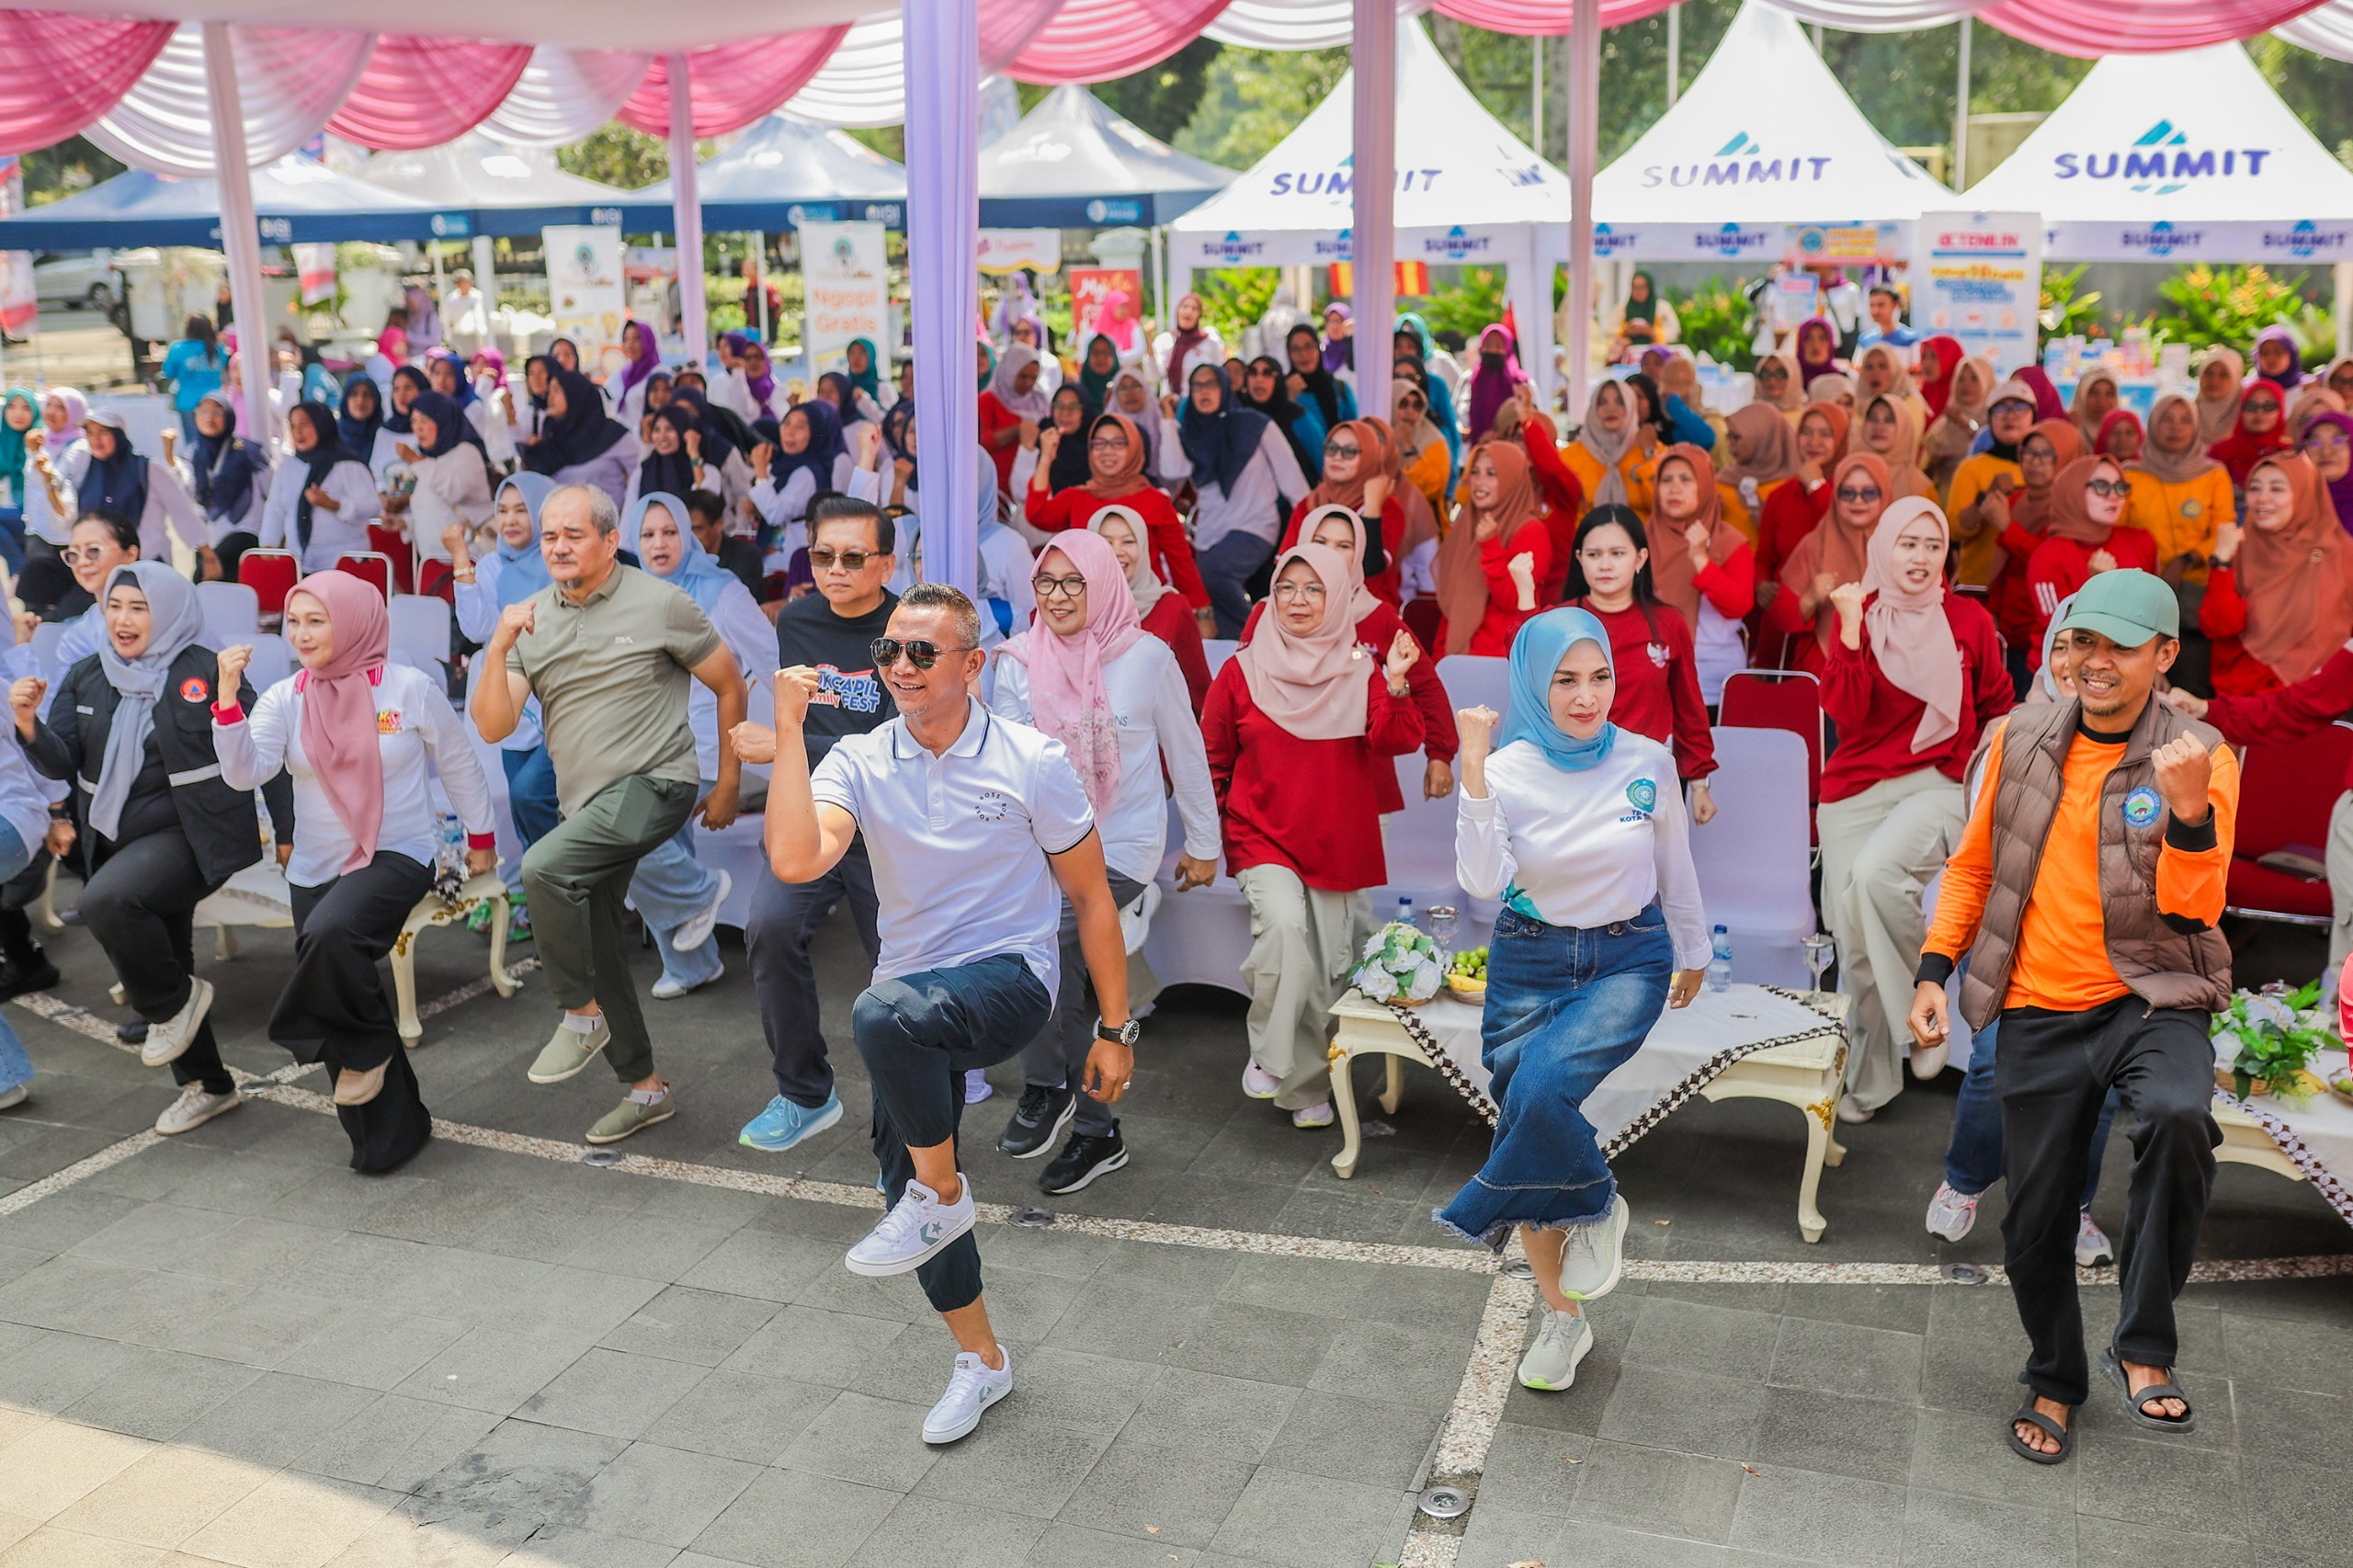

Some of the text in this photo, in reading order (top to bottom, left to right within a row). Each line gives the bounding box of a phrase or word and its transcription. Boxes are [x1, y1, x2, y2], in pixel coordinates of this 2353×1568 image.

[1641, 157, 1832, 187] SUMMIT
[2054, 149, 2271, 179] SUMMIT
[1270, 169, 1443, 196] SUMIT
[1425, 237, 1490, 252] SUMMIT
[1696, 233, 1766, 247] SUMMIT
[2122, 232, 2201, 246] SUMMIT
[2262, 232, 2346, 246] SUMMIT
[813, 287, 878, 310] Ngopi
[815, 312, 878, 334] Gratis
[818, 674, 880, 699] KCAPIL
[809, 691, 880, 712] mily FEST
